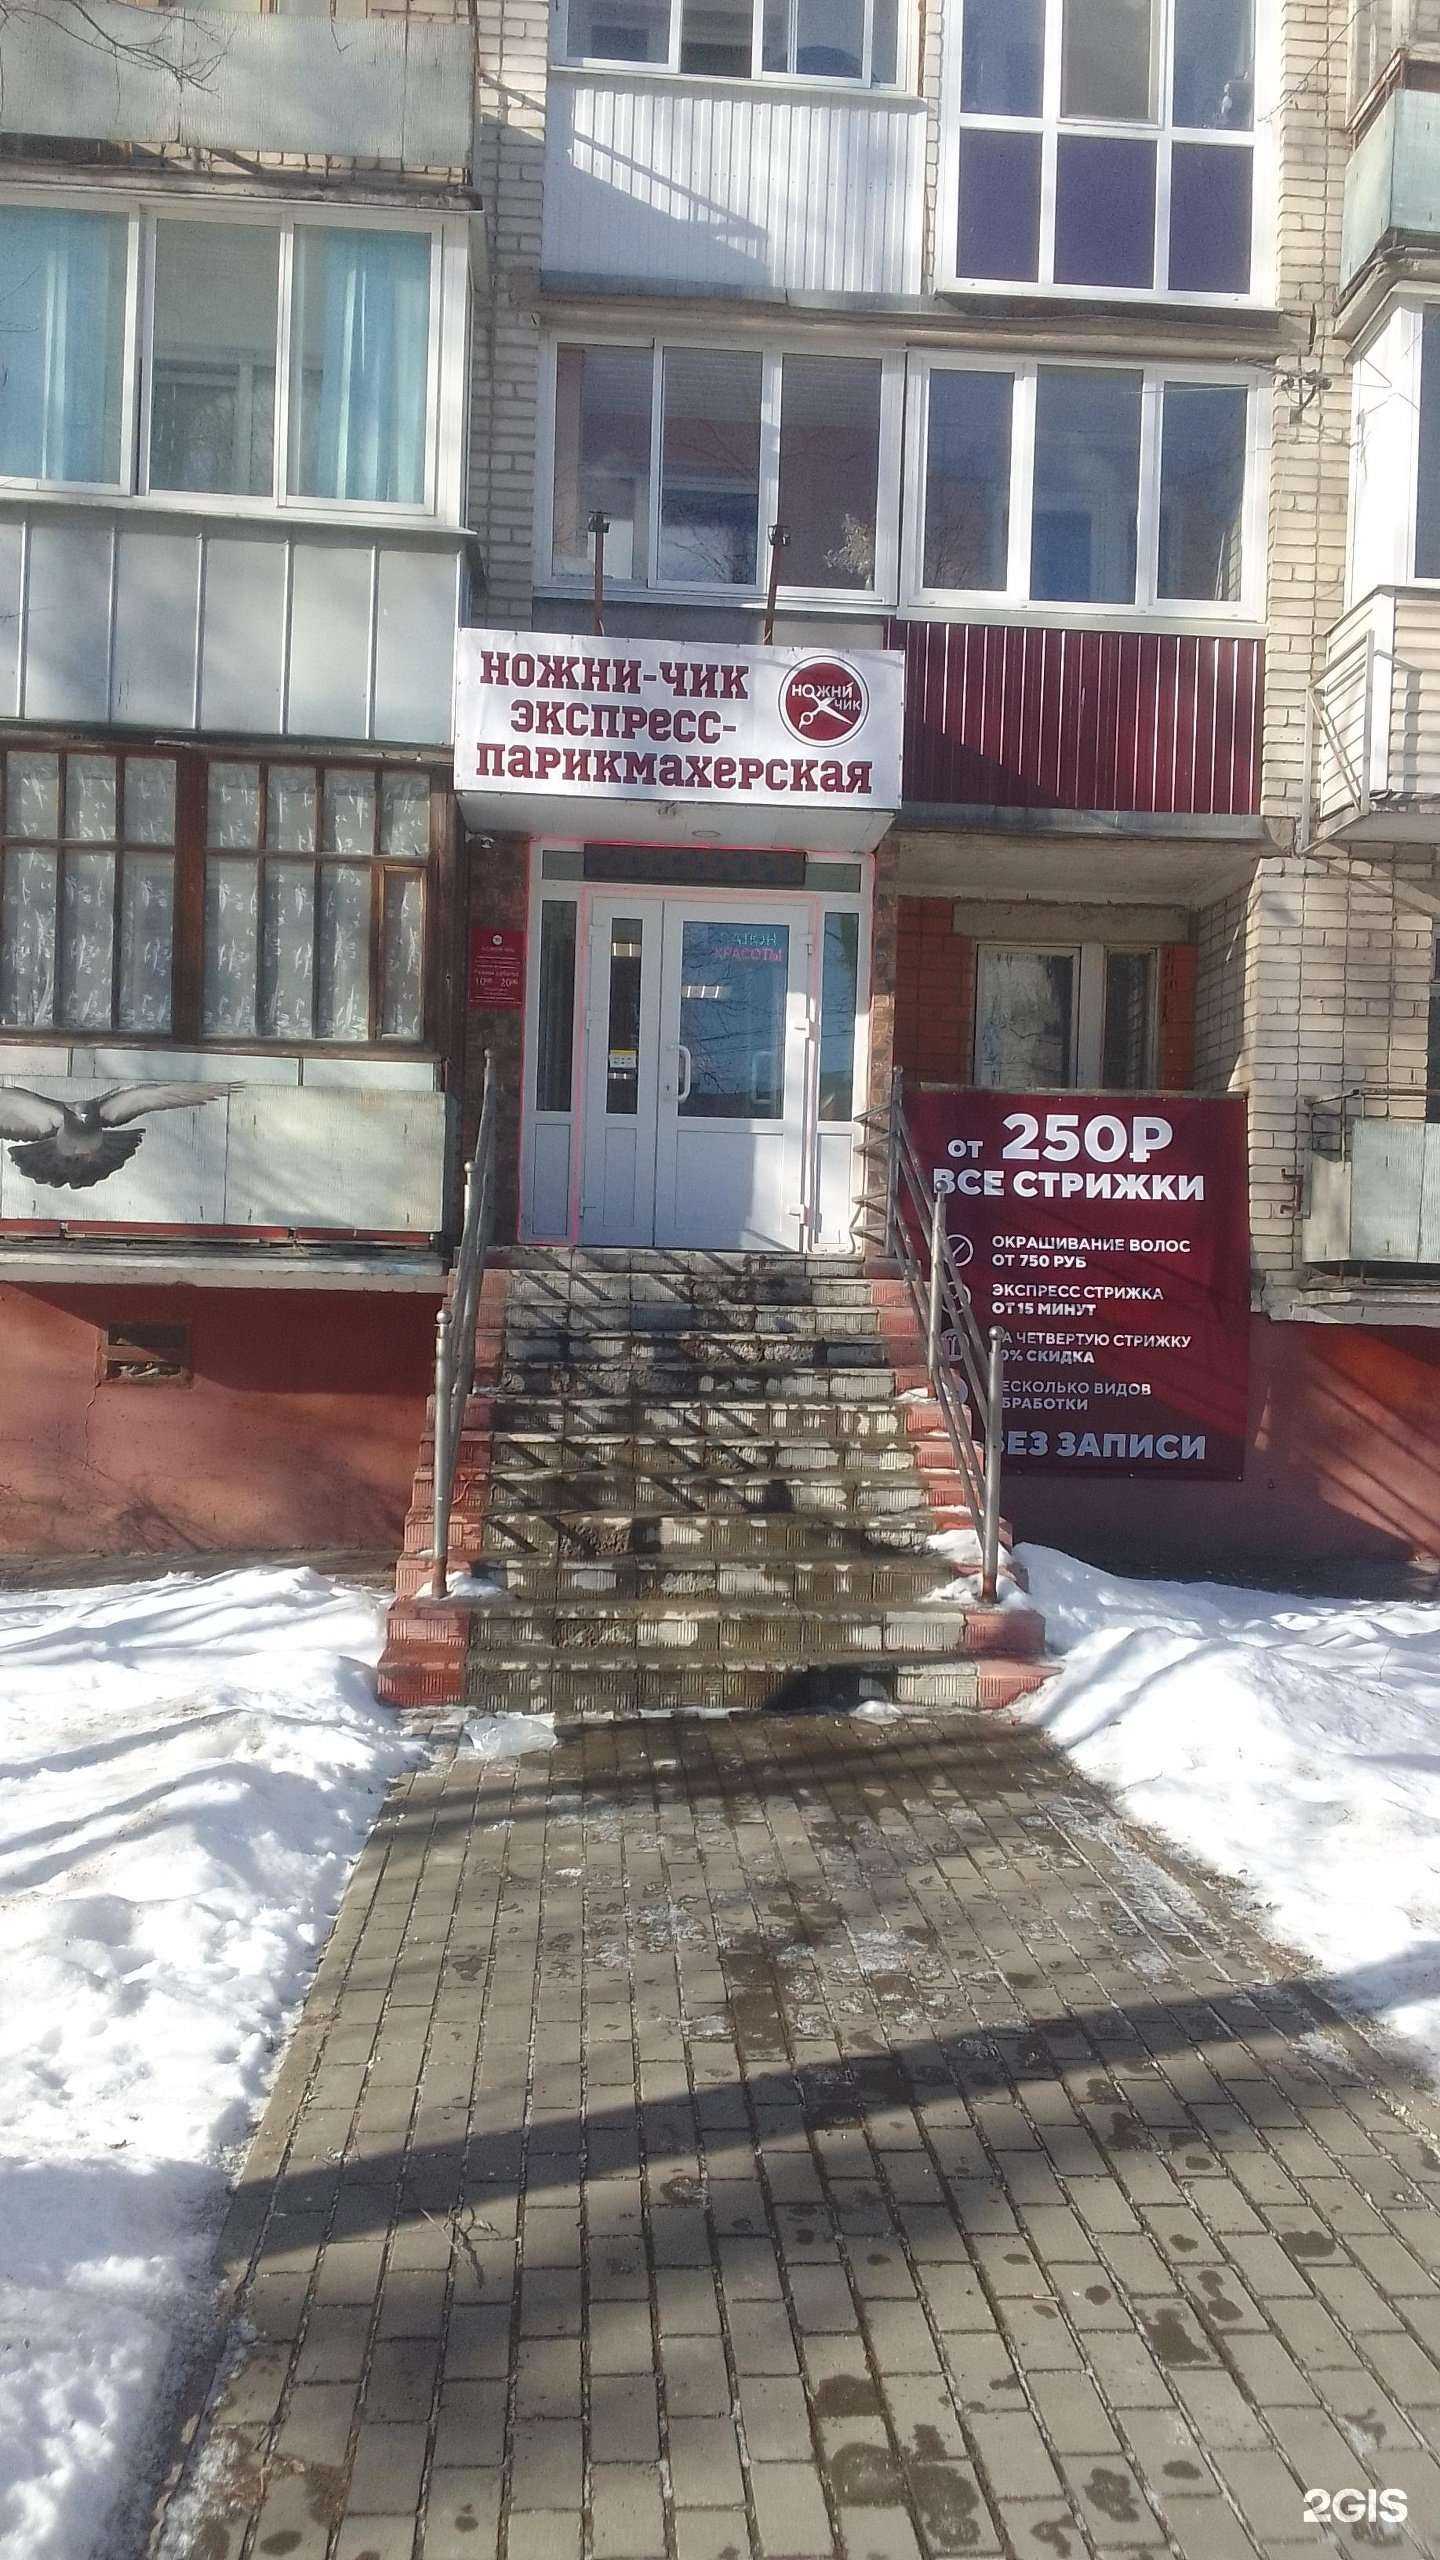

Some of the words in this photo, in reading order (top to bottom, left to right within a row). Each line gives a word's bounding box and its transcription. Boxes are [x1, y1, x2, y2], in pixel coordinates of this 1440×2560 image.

[480, 651, 749, 700] НОЖНИ-ЧИК
[834, 699, 861, 711] ЧИК
[947, 1139, 984, 1158] ОТ
[933, 1168, 1005, 1196] ВСЕ
[1013, 1171, 1205, 1200] СТРИЖКИ
[992, 1235, 1125, 1251] ОКРАШИВАНИЕ
[1129, 1239, 1191, 1253] ВОЛОС
[992, 1254, 1015, 1266] ОТ
[1019, 1254, 1050, 1267] 750
[1053, 1255, 1087, 1268] РУБ
[992, 1284, 1081, 1298] ЭКСПРЕСС
[1083, 1286, 1164, 1300] СТРИЖКА
[992, 1302, 1015, 1314] ОТ
[1017, 1302, 1034, 1314] 15
[1037, 1302, 1097, 1316] МИНУТ
[1017, 1332, 1109, 1346] ЧЕТВЕРТУЮ
[1113, 1334, 1191, 1348] СТРИЖКУ
[1026, 1350, 1095, 1364] СКИДКА
[1001, 1380, 1089, 1394] ЕСКОЛЬКО
[1094, 1383, 1151, 1396] ВИДОВ
[1001, 1397, 1088, 1411] БРАБОТКИ
[1000, 1430, 1049, 1456] ЕЗ
[1055, 1431, 1206, 1461] ЗАПИСИ
